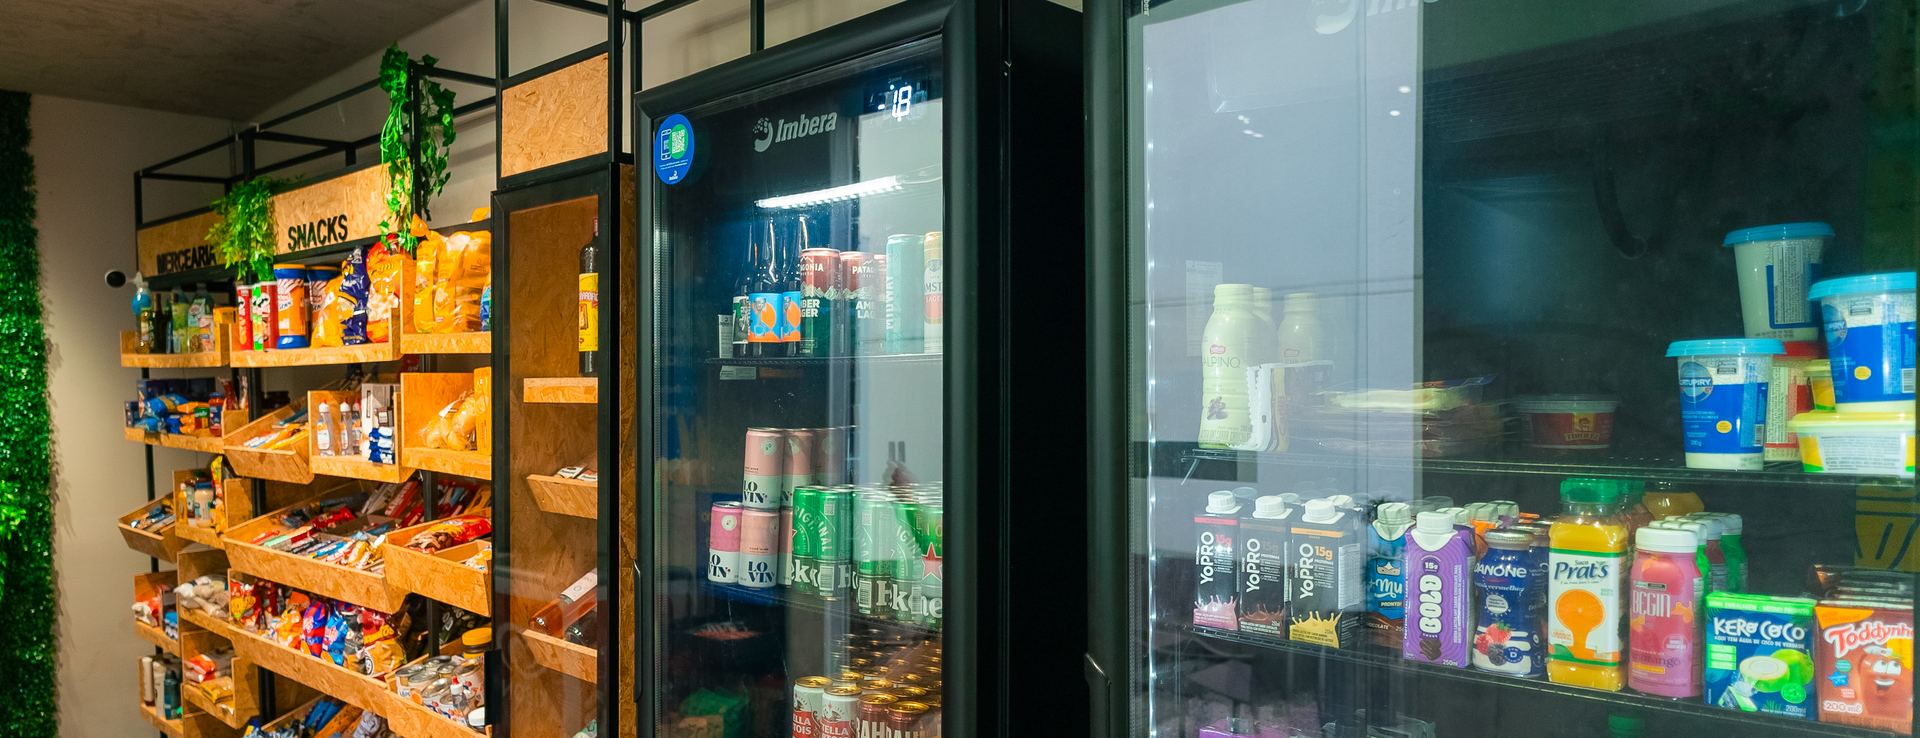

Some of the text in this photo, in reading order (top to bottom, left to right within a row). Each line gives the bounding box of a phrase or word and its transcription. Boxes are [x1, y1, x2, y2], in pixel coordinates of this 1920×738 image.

[775, 112, 838, 143] Imbera
[288, 215, 348, 251] SNACKS
[157, 244, 217, 274] MERCEARIA
[801, 309, 819, 318] GER
[802, 299, 820, 309] BER
[1315, 545, 1333, 561] 15g
[748, 561, 768, 572] LO
[1246, 538, 1260, 593] YoPRO
[1299, 543, 1314, 600] YoPRO
[1419, 574, 1442, 634] BOLD
[1713, 616, 1806, 643] KERO COCO
[793, 714, 812, 726] ELLA
[793, 725, 812, 735] TOIS
[822, 725, 849, 735] TELLA
